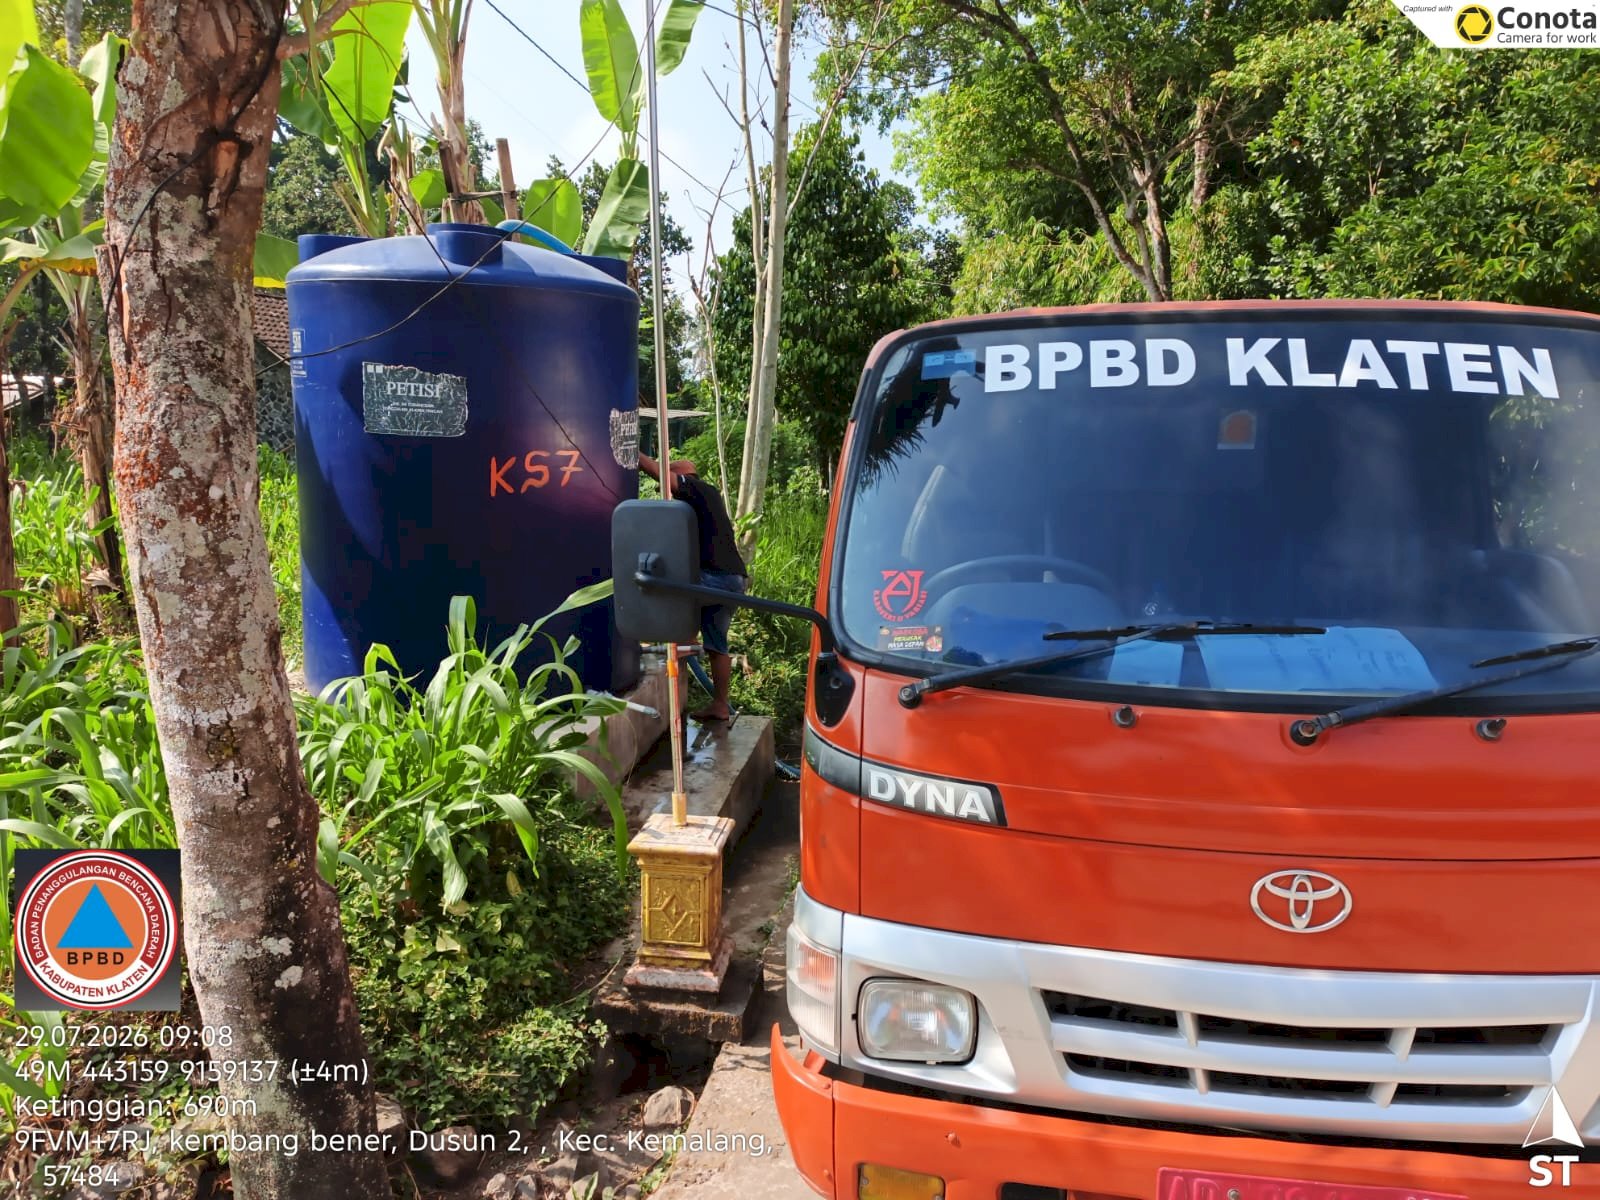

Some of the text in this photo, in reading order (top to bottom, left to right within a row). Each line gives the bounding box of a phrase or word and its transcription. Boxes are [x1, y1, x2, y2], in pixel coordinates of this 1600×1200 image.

[984, 337, 1560, 399] BPBD KLATEN
[868, 770, 991, 822] DYNA
